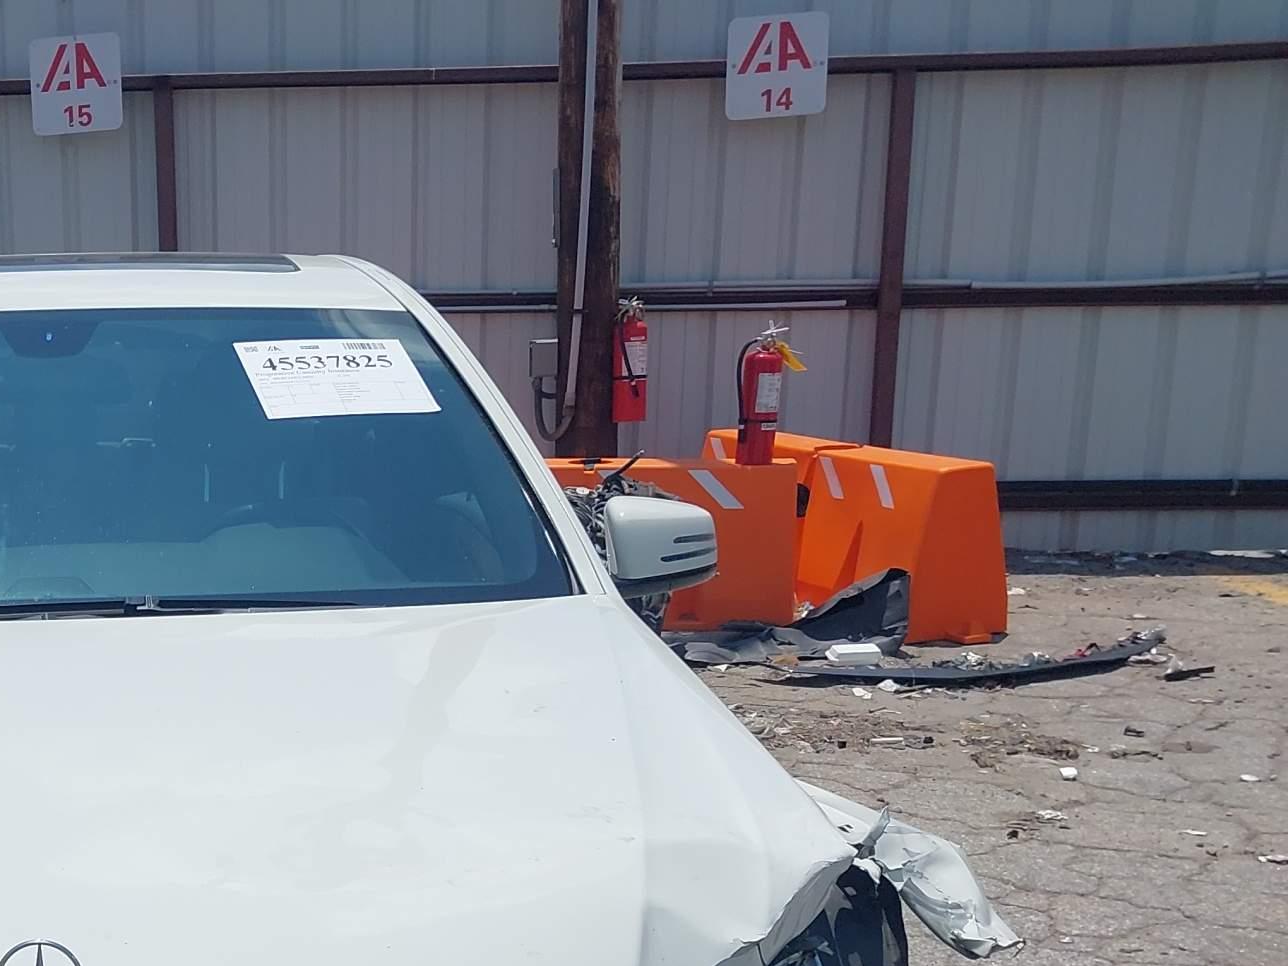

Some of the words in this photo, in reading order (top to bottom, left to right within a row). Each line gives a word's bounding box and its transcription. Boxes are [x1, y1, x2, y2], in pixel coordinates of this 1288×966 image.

[761, 87, 793, 112] 14
[63, 104, 93, 127] 15
[262, 354, 393, 371] 45537825
